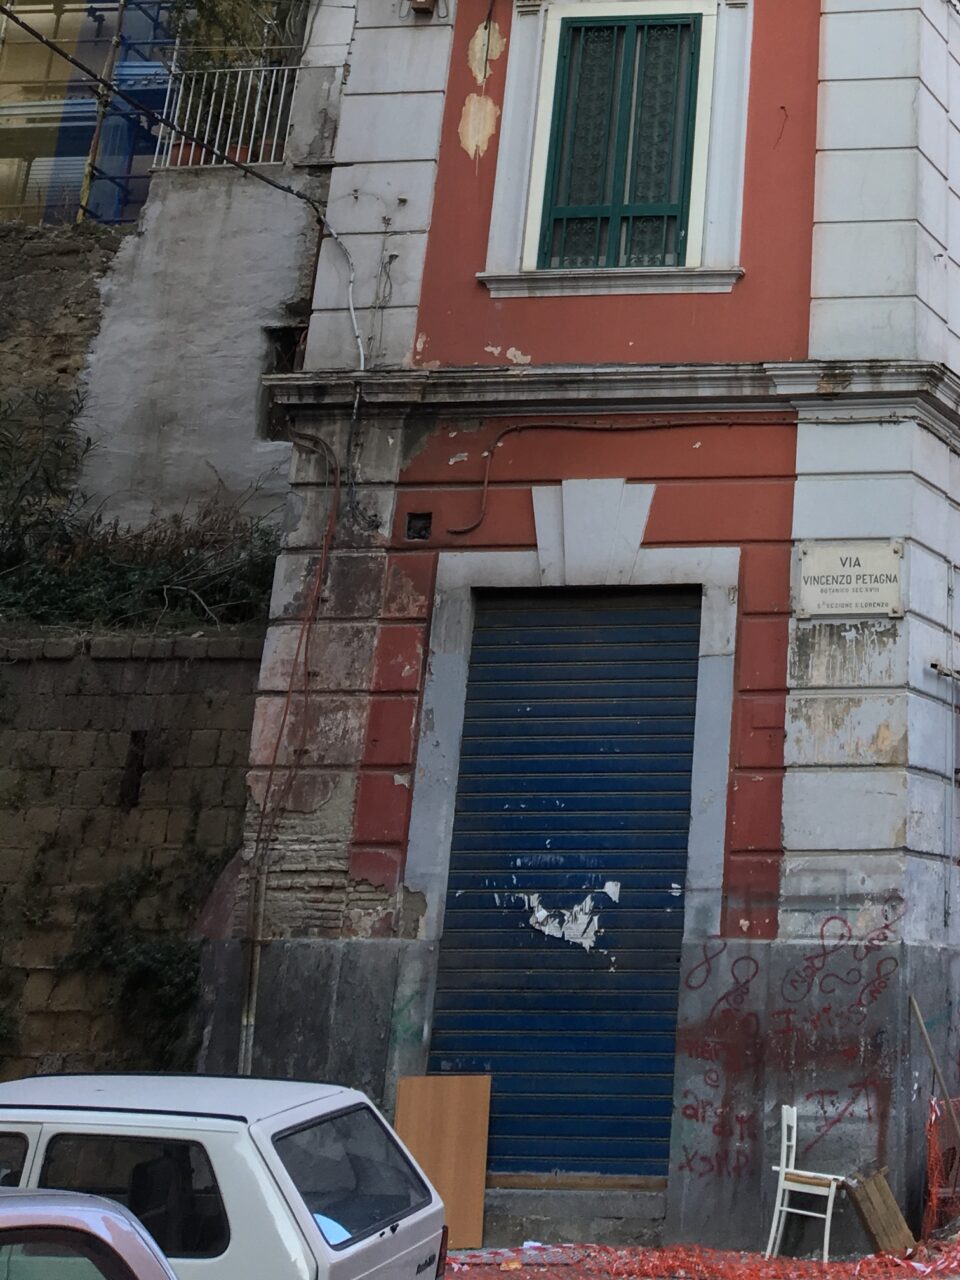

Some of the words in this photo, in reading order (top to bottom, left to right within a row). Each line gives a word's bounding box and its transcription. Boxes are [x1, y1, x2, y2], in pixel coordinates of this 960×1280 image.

[840, 556, 861, 568] VIA
[803, 575, 852, 586] VINCENZO
[856, 573, 898, 585] PETAGNA
